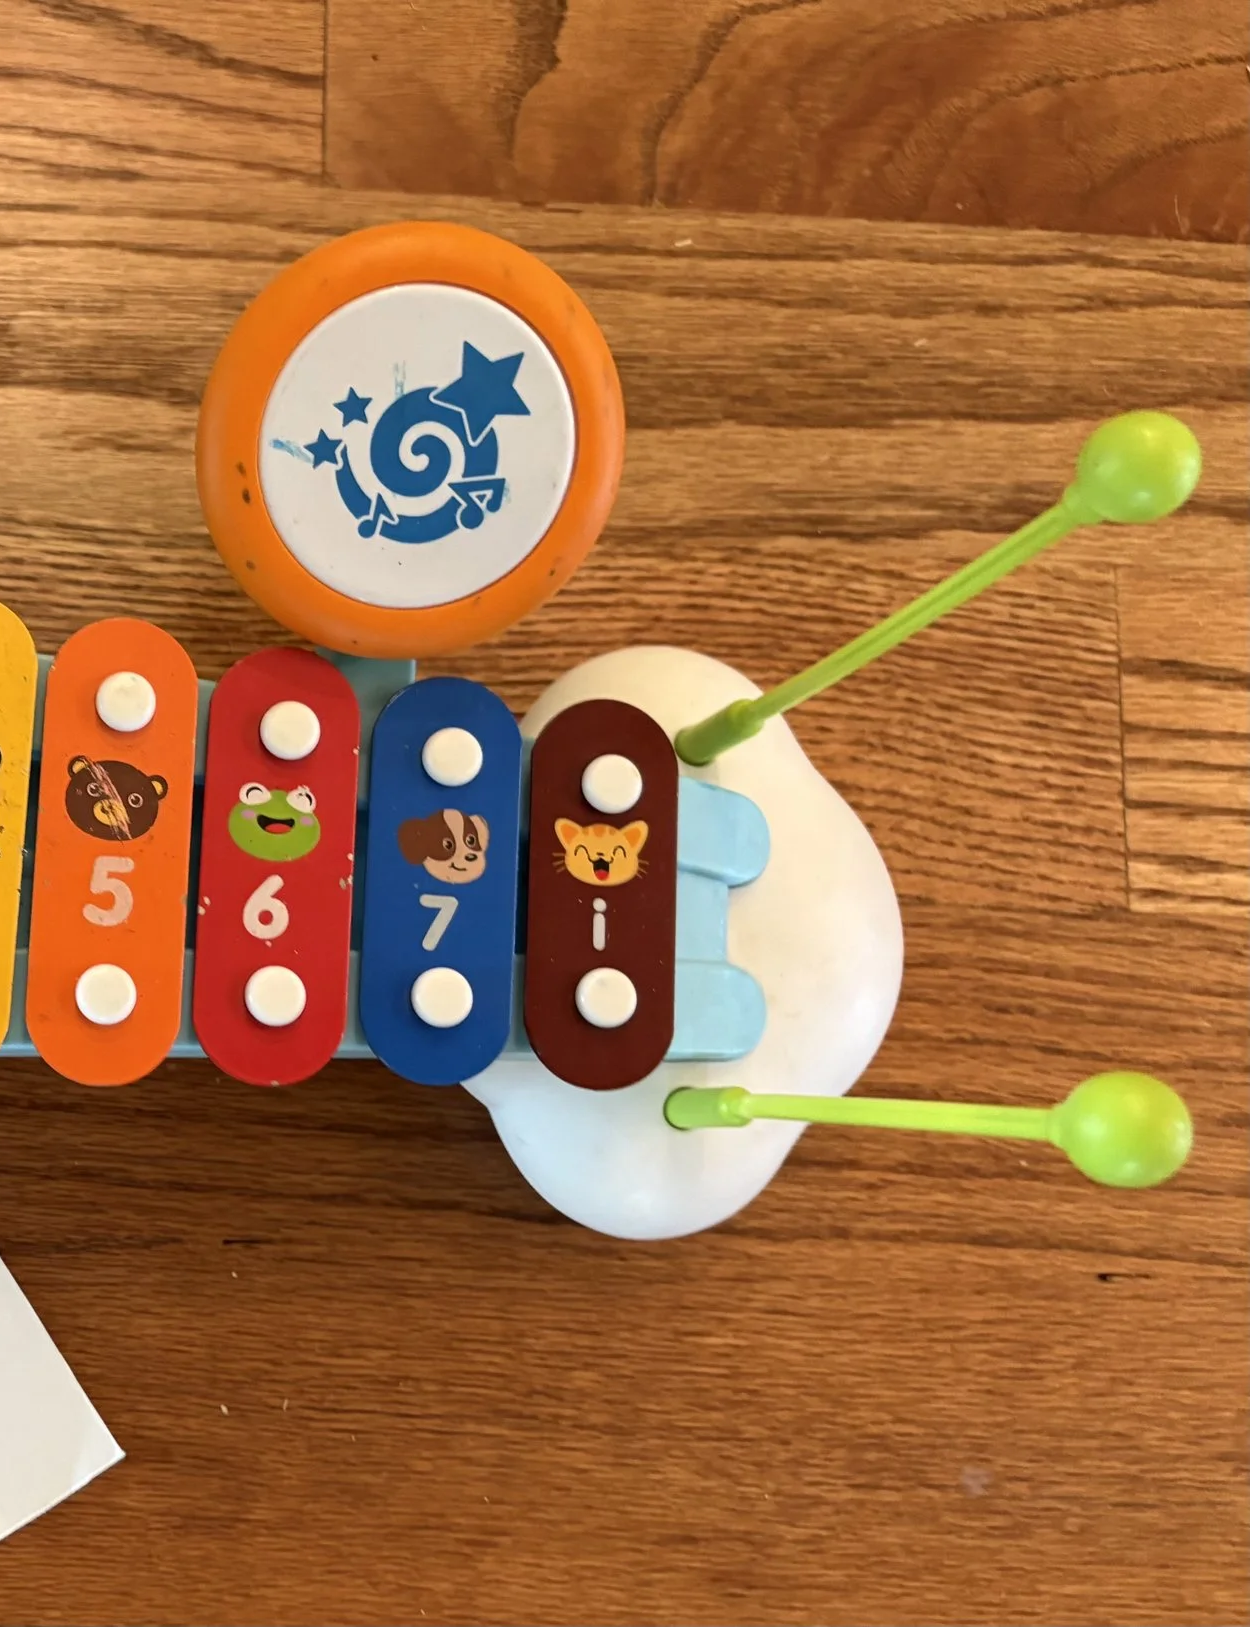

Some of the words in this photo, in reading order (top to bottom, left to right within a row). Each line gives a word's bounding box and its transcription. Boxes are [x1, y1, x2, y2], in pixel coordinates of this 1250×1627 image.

[82, 856, 136, 927] 5
[242, 874, 290, 940] 6
[419, 894, 459, 952] 7
